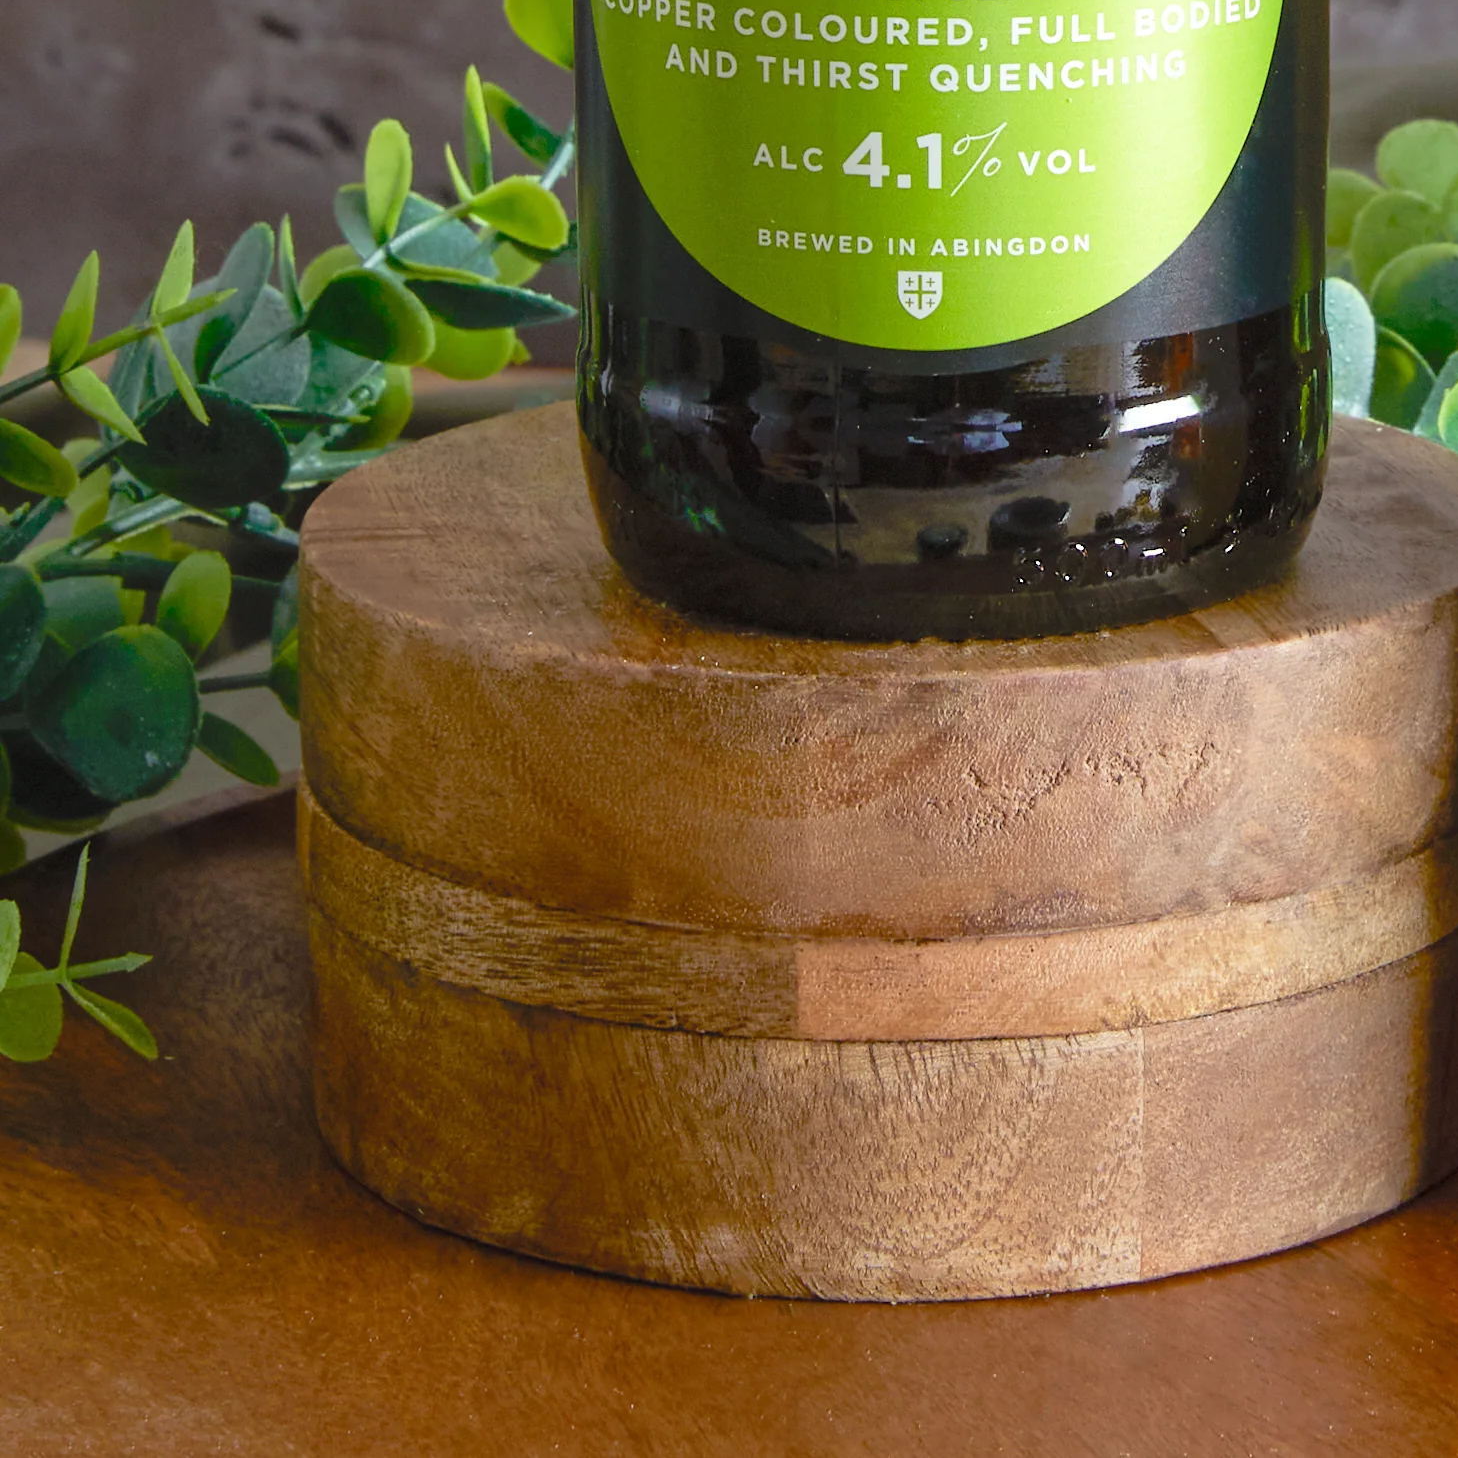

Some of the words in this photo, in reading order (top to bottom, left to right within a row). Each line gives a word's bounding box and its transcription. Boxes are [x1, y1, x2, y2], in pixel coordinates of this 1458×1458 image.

[734, 8, 988, 52] COLOURED,
[1012, 12, 1116, 44] FULL
[666, 44, 737, 78] AND
[756, 56, 908, 90] THIRST
[930, 49, 1187, 92] QUENCHING
[754, 144, 823, 172] ALC
[843, 122, 1007, 196] 4.1%
[1018, 149, 1096, 175] VOL
[759, 229, 873, 254] BREWED
[889, 238, 915, 255] IN
[931, 233, 1090, 256] ABINGDON
